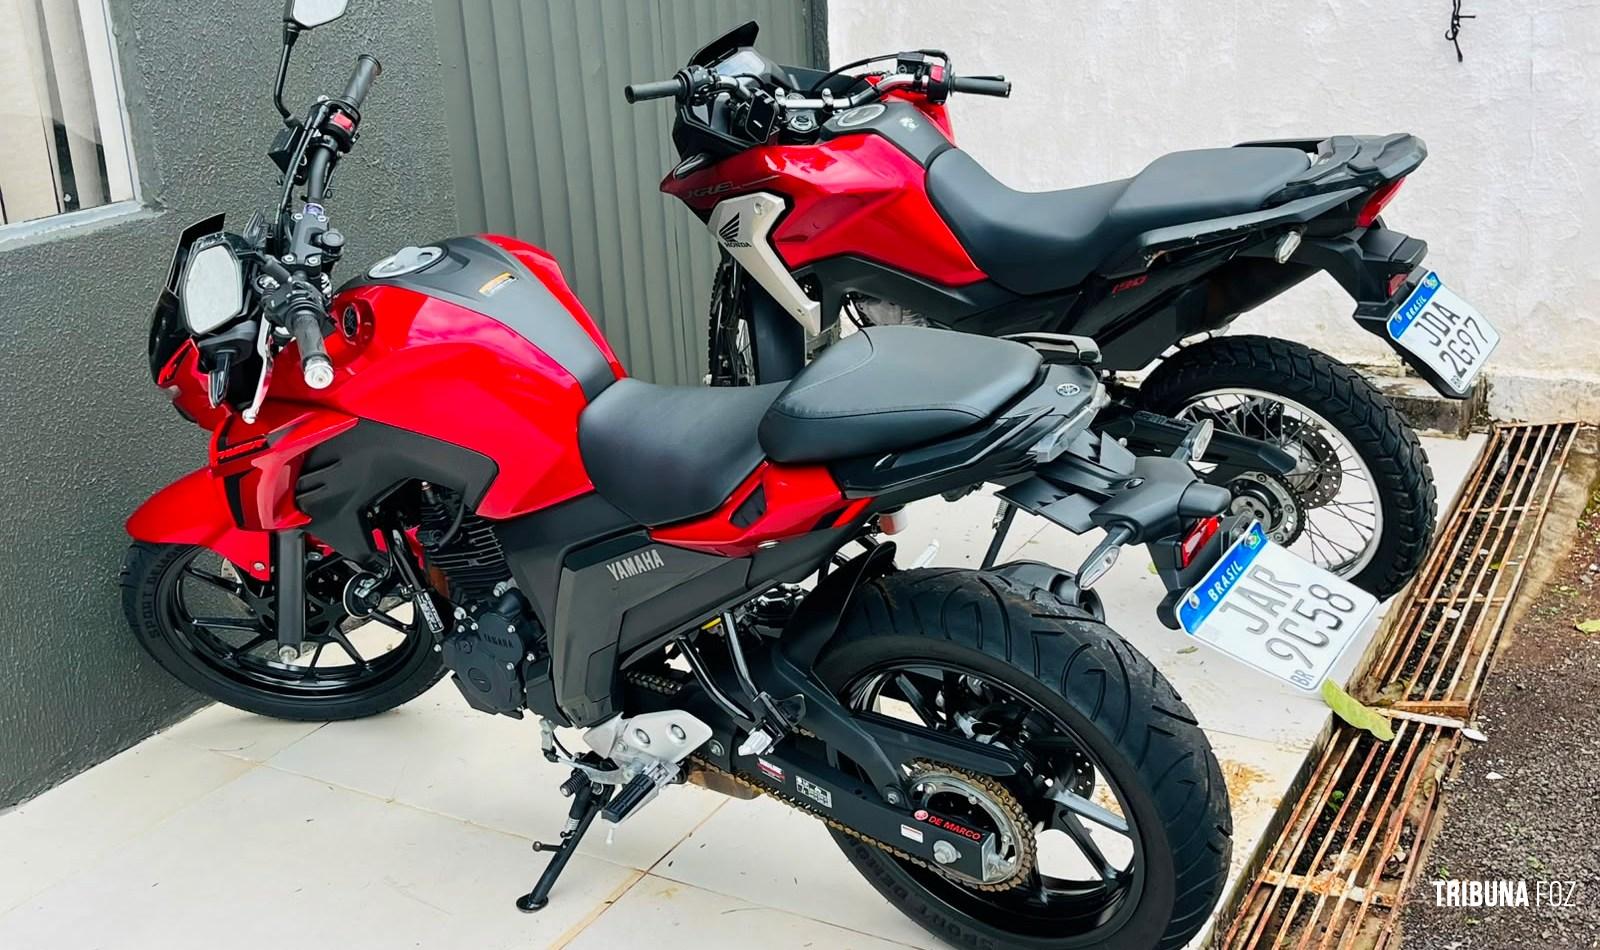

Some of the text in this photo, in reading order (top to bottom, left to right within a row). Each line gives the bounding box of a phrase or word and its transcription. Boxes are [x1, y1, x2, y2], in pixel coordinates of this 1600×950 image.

[1414, 301, 1461, 347] JDA
[1439, 316, 1489, 379] 2G97
[606, 549, 664, 581] YAMAHA
[1207, 560, 1244, 602] BRASIL
[1219, 564, 1301, 635] JAR
[1265, 583, 1357, 670] 9C58
[1290, 669, 1315, 687] BR
[928, 815, 981, 840] DE MARCO
